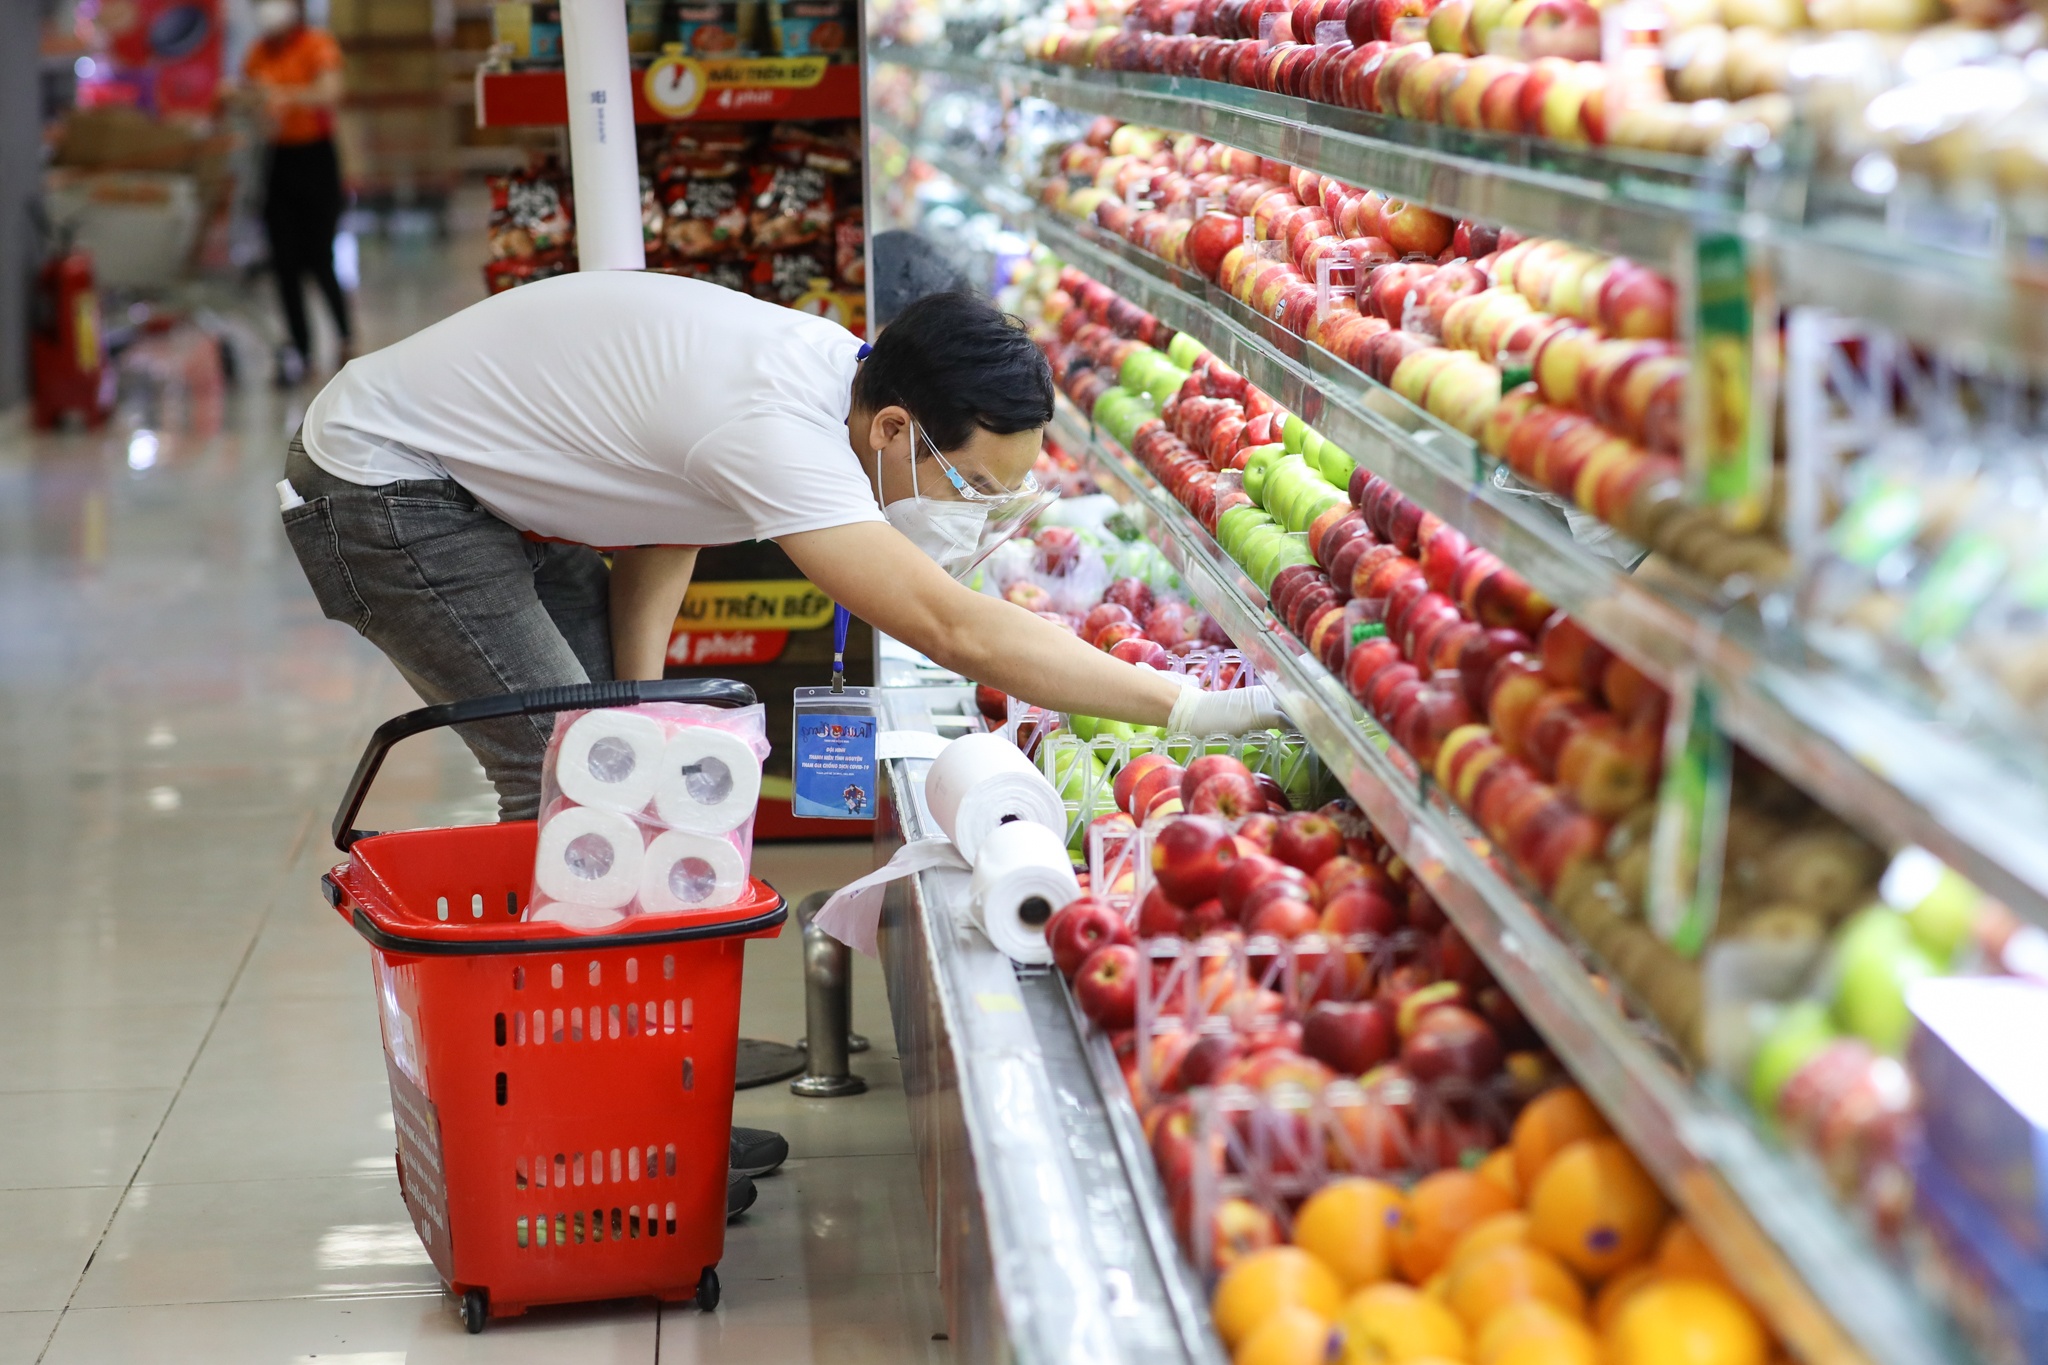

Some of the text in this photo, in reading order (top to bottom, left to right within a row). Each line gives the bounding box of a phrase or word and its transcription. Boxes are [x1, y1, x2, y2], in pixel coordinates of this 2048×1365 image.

[717, 89, 732, 109] 4
[714, 592, 778, 618] TRÊN
[783, 590, 830, 618] BẾP
[668, 632, 757, 664] 4 phút
